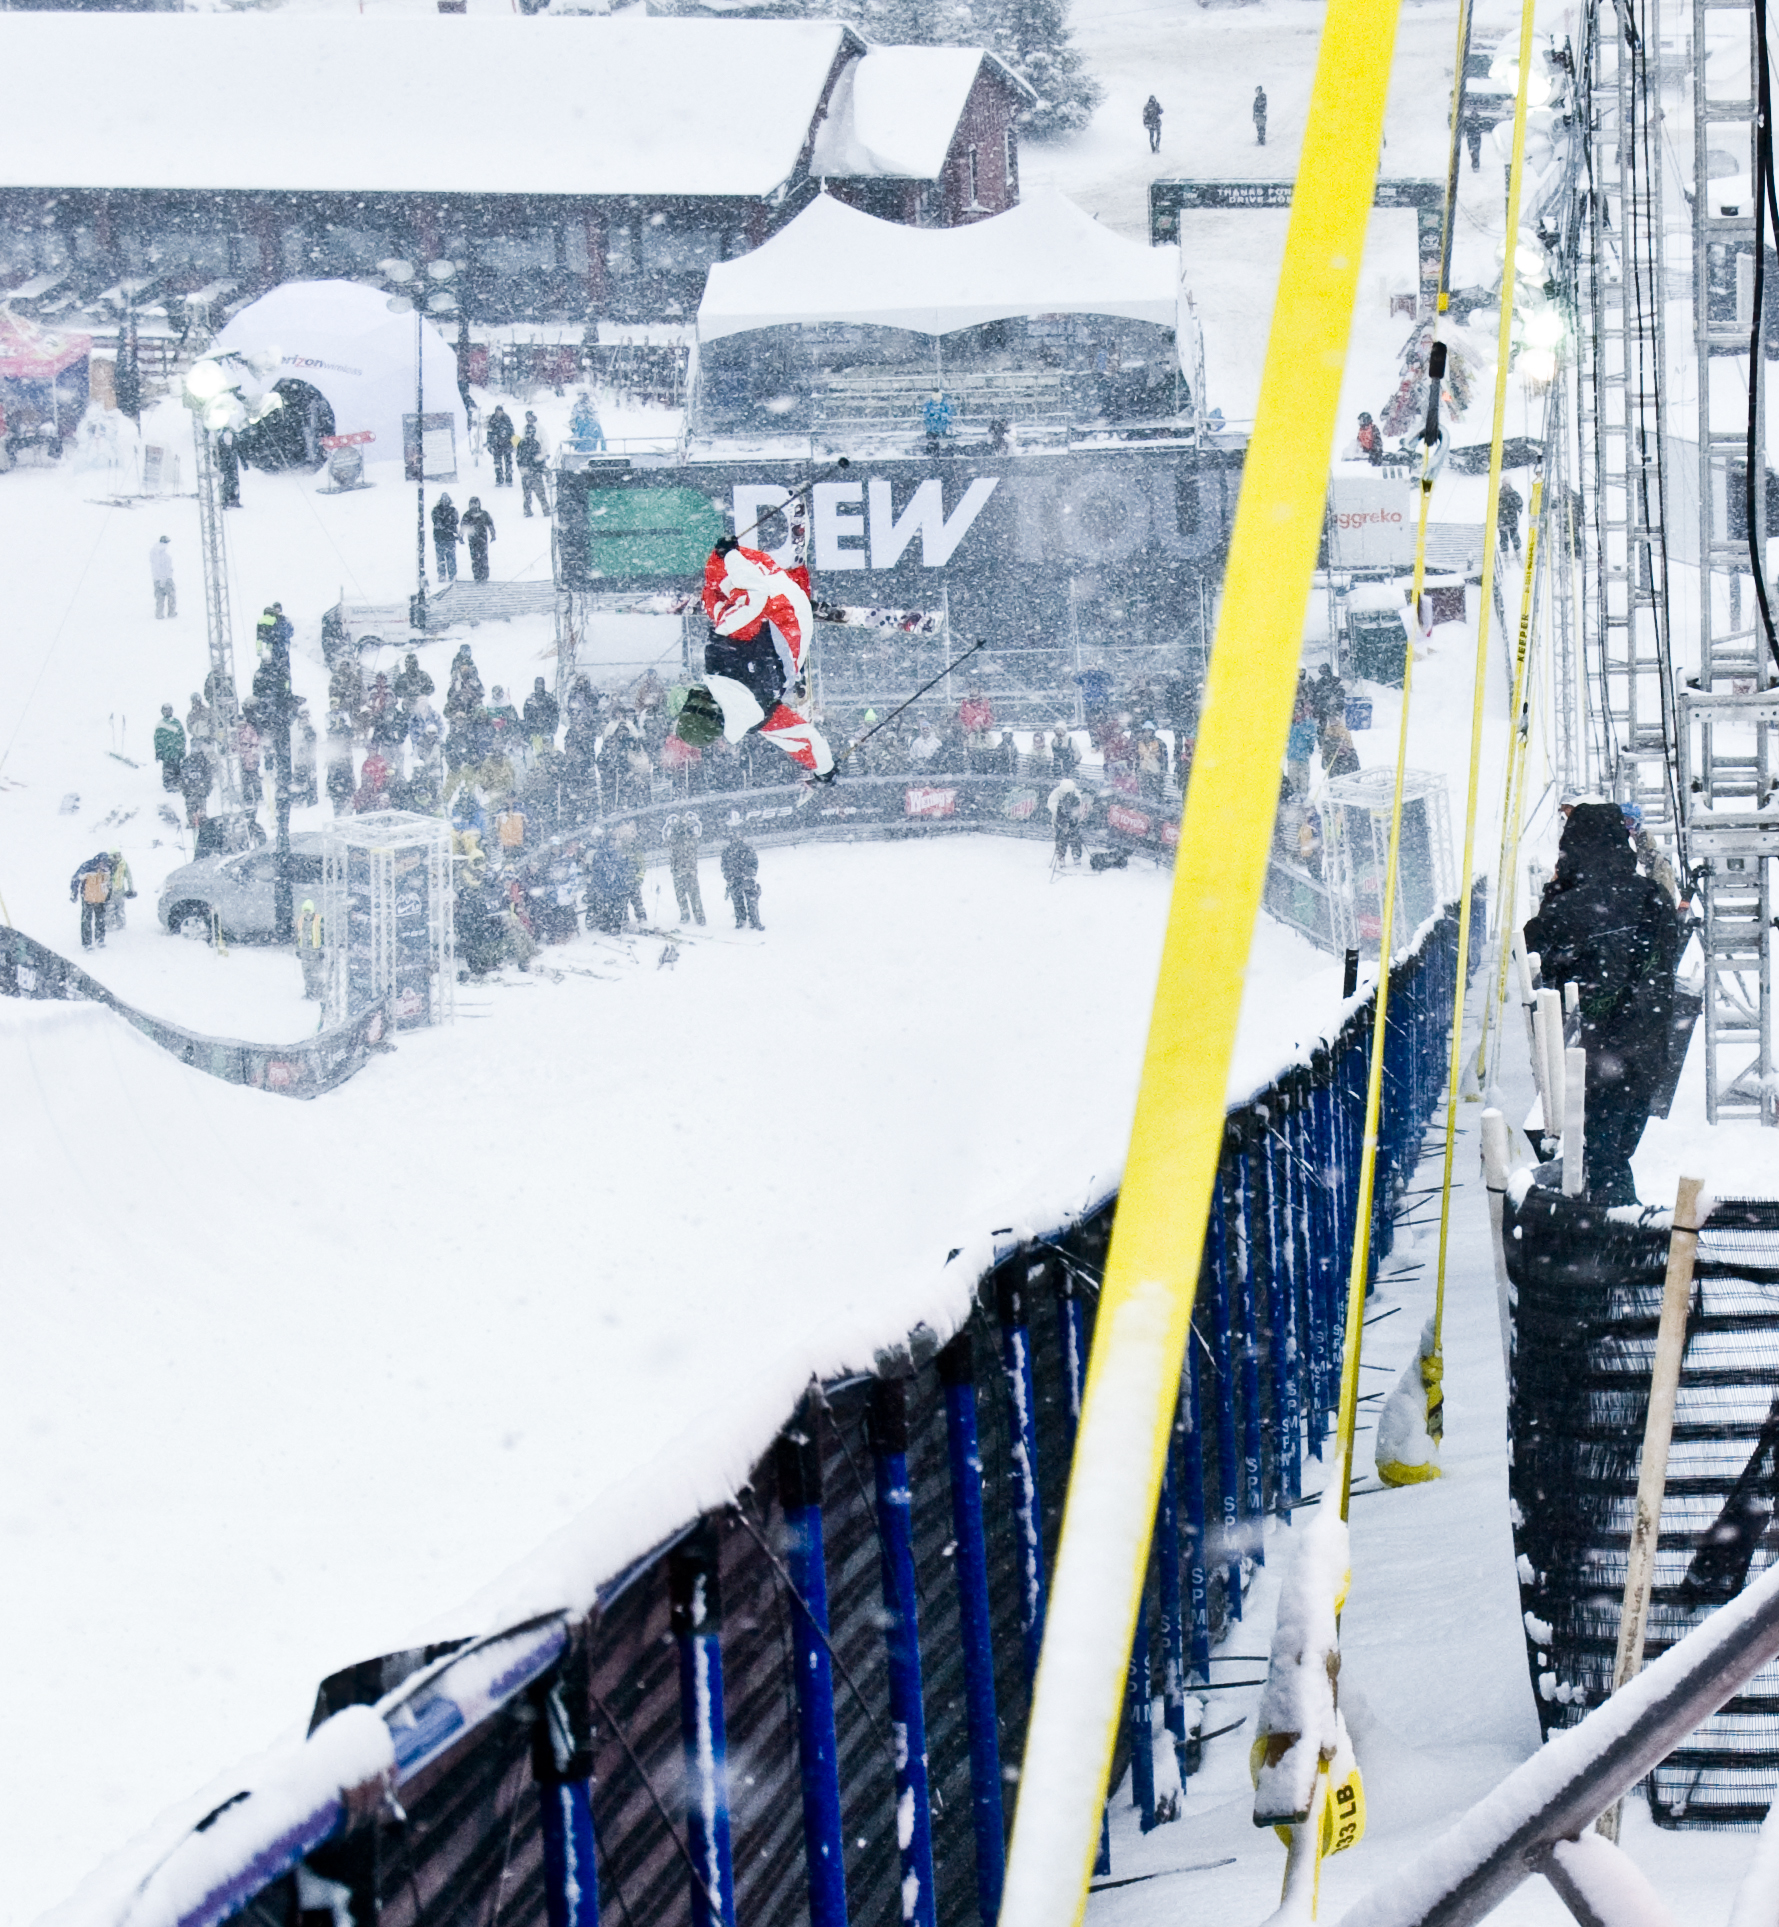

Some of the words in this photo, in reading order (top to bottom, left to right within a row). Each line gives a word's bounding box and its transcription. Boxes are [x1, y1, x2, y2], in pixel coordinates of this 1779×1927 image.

[733, 477, 1000, 570] DEW
[1001, 468, 1246, 567] TOU
[1517, 614, 1529, 662] KEEPER
[746, 806, 793, 820] PS3
[1285, 1382, 1298, 1428] SPM
[1246, 1456, 1260, 1508] SPM
[1223, 1496, 1240, 1550] SPM
[1191, 1567, 1207, 1625] SPM
[1336, 1785, 1357, 1820] LB
